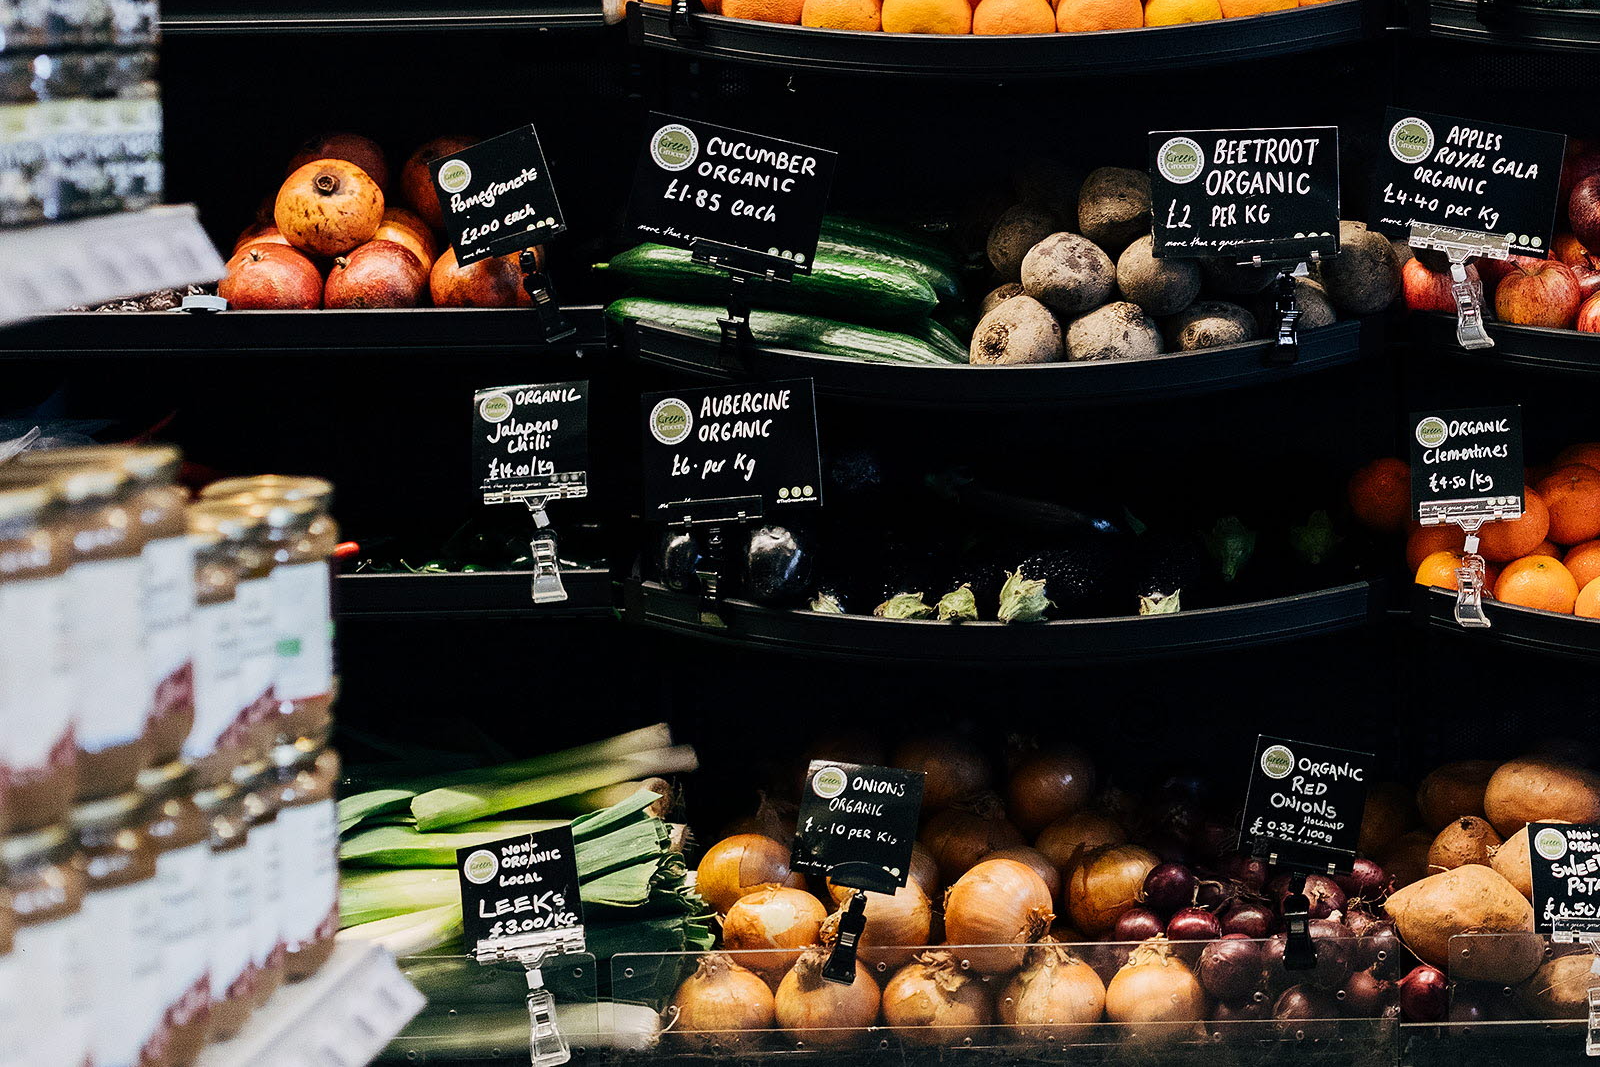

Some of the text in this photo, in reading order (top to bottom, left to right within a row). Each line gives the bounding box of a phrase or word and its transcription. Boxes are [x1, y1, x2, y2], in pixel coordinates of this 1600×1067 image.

[1397, 131, 1427, 144] Green
[1446, 125, 1503, 152] APPLES
[706, 136, 817, 177] CUCUMBER
[1165, 152, 1197, 163] Green
[1213, 137, 1320, 166] BEETROOT
[1433, 146, 1539, 180] ROYAL GALA
[450, 167, 538, 214] Pomegranate
[698, 161, 796, 193] ORGANIC
[1204, 169, 1311, 197] ORGANIC
[1413, 166, 1487, 195] ORGANIC
[663, 178, 776, 223] £1.85 each
[1165, 198, 1271, 229] £2 PER KG
[1383, 182, 1439, 212] £4.40
[1444, 203, 1472, 219] per
[460, 203, 536, 246] £2.00 each
[515, 388, 581, 405] ORGANIC
[700, 389, 791, 419] AUBERGINE
[486, 417, 559, 444] Jalapeno
[698, 419, 773, 443] ORGANIC
[1448, 418, 1511, 438] ORGANIC
[701, 459, 727, 480] per
[1298, 757, 1364, 782] ORGANIC
[852, 777, 906, 797] ONIONS
[1291, 775, 1328, 795] RED
[829, 797, 884, 817] ORGANIC
[1270, 792, 1337, 819] ONIONS
[501, 848, 562, 869] ORGANIC
[500, 871, 543, 887] LOCAL
